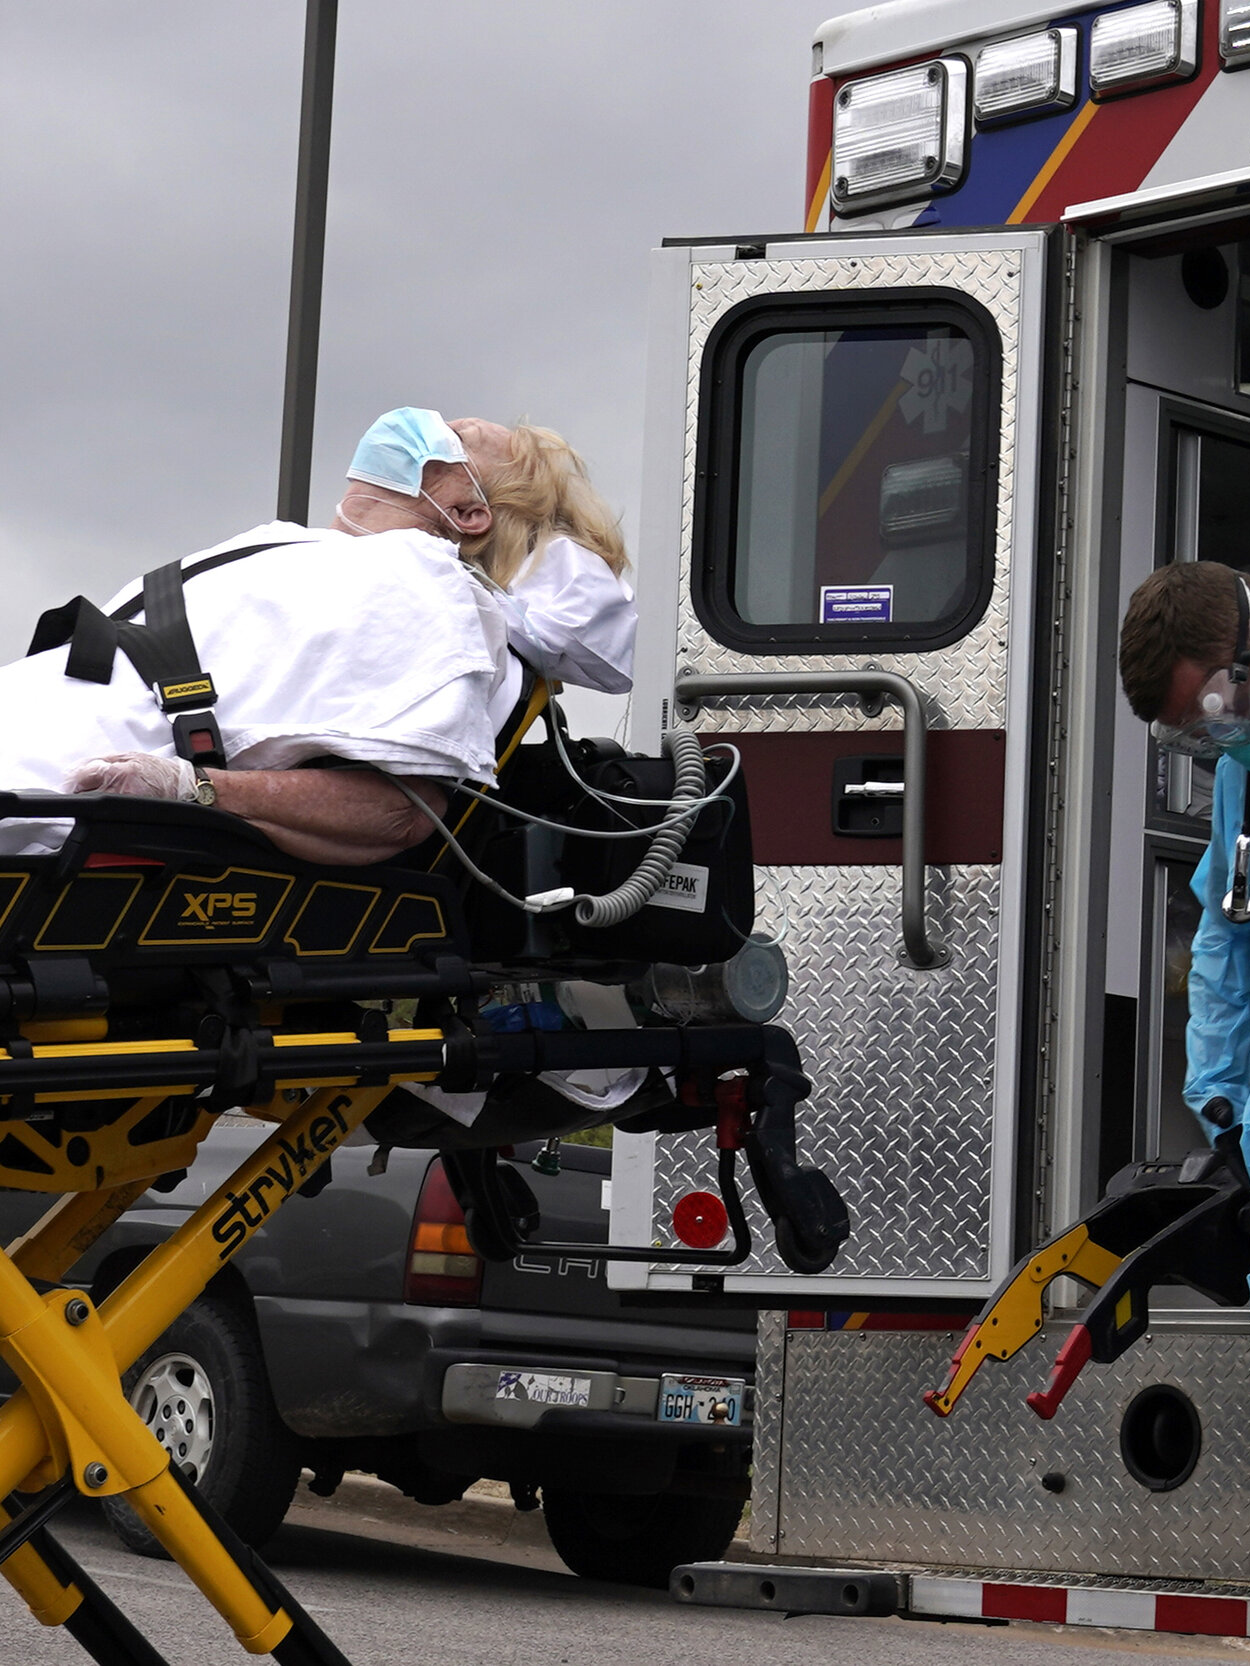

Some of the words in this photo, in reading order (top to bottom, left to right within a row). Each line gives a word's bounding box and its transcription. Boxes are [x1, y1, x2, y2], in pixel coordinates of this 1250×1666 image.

[917, 362, 958, 398] 911
[181, 893, 257, 921] XPS
[212, 1095, 353, 1260] stryker
[665, 1394, 693, 1418] GGH
[708, 1396, 736, 1421] 20
